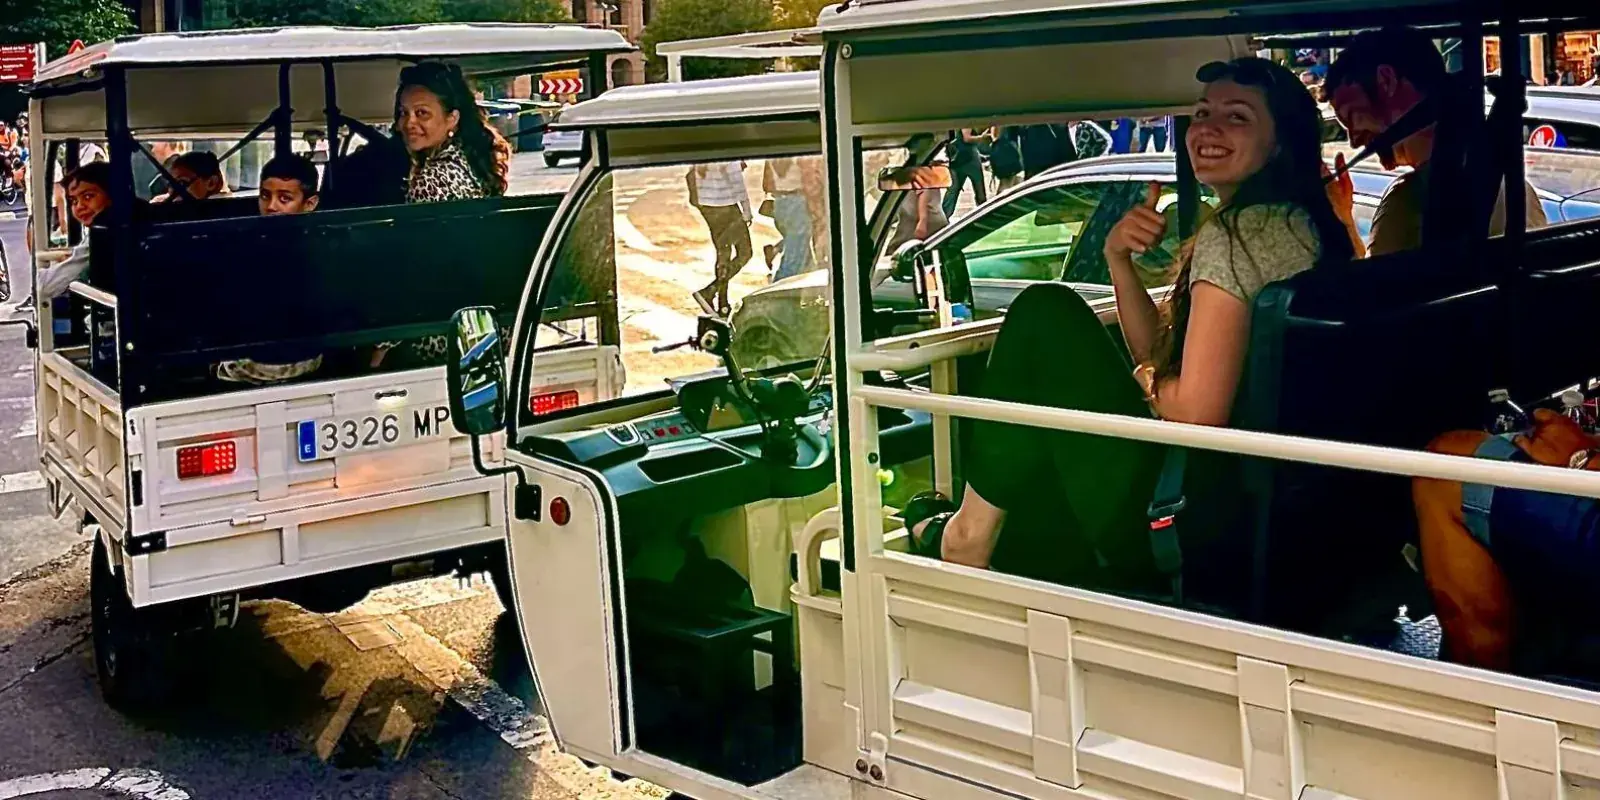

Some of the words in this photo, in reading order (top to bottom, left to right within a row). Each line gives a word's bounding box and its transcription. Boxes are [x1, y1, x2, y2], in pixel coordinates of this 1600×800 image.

[321, 414, 400, 452] 3326
[414, 406, 450, 438] MP
[304, 444, 311, 453] E
